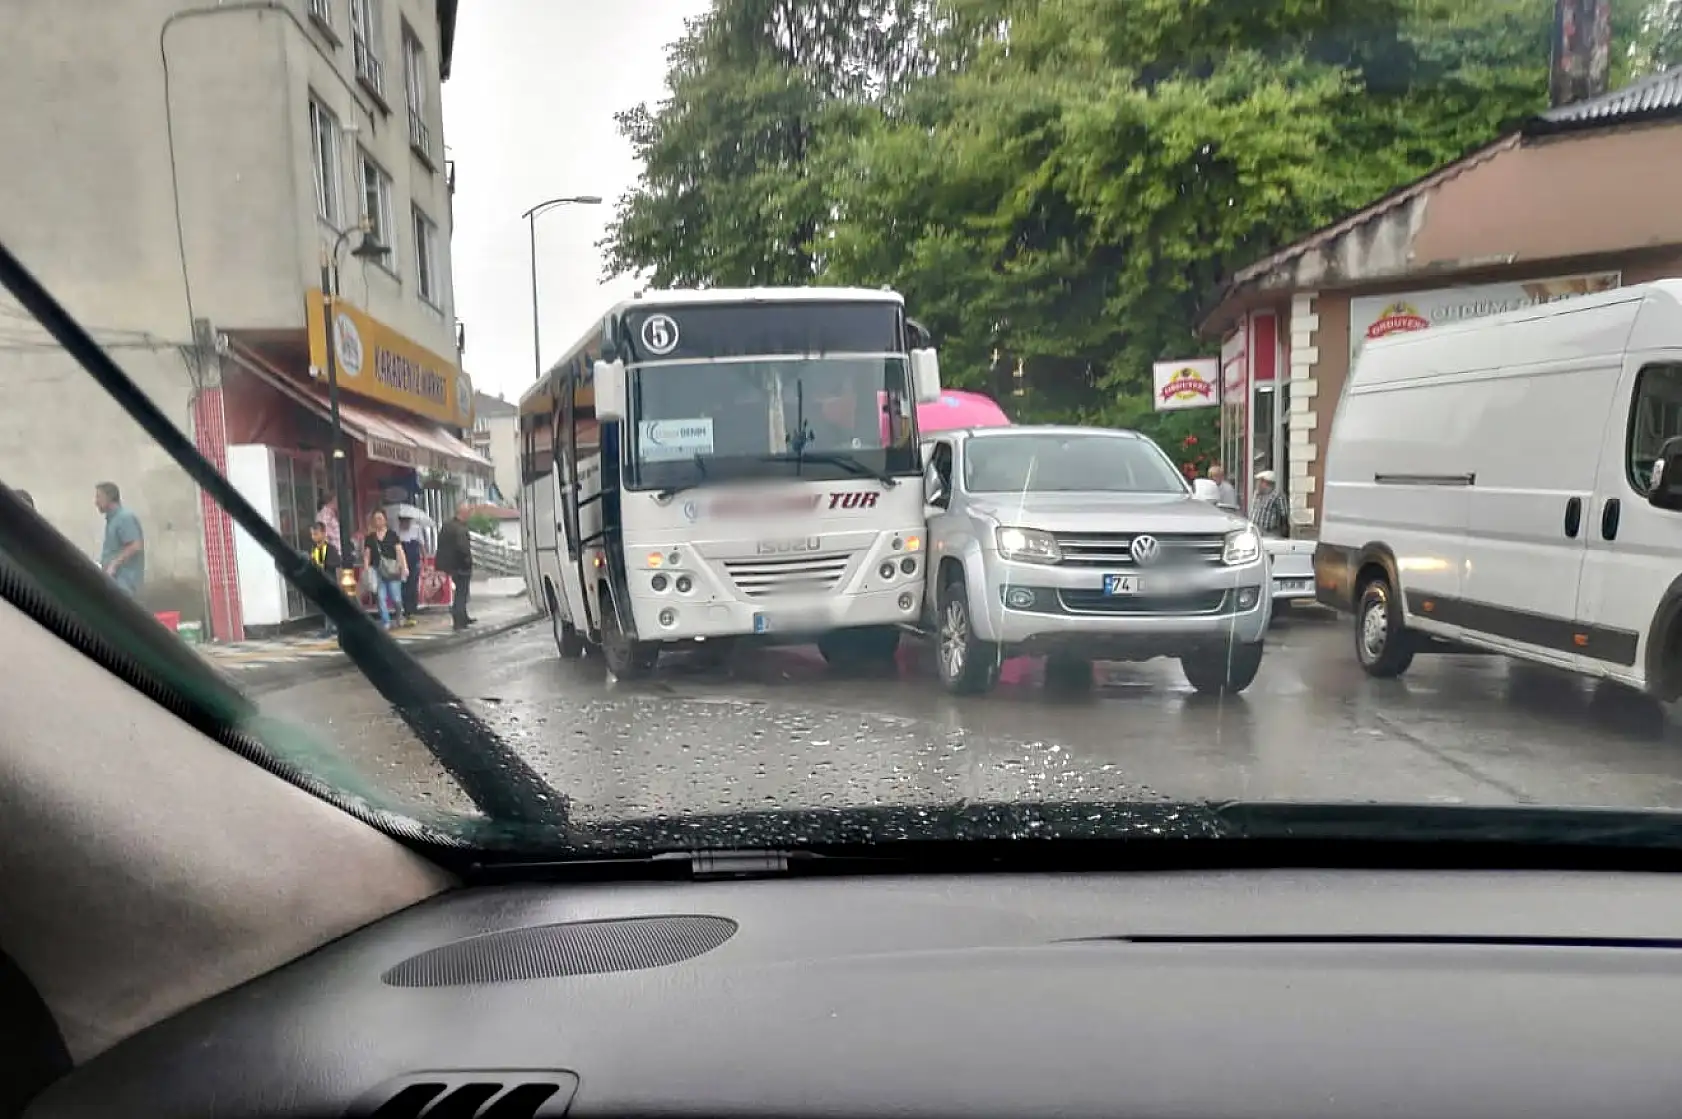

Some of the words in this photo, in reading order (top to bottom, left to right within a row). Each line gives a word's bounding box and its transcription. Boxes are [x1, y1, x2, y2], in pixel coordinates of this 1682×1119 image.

[652, 319, 669, 348] 5
[827, 491, 880, 509] TUR
[757, 536, 821, 555] ISUZU
[1111, 576, 1129, 592] 74
